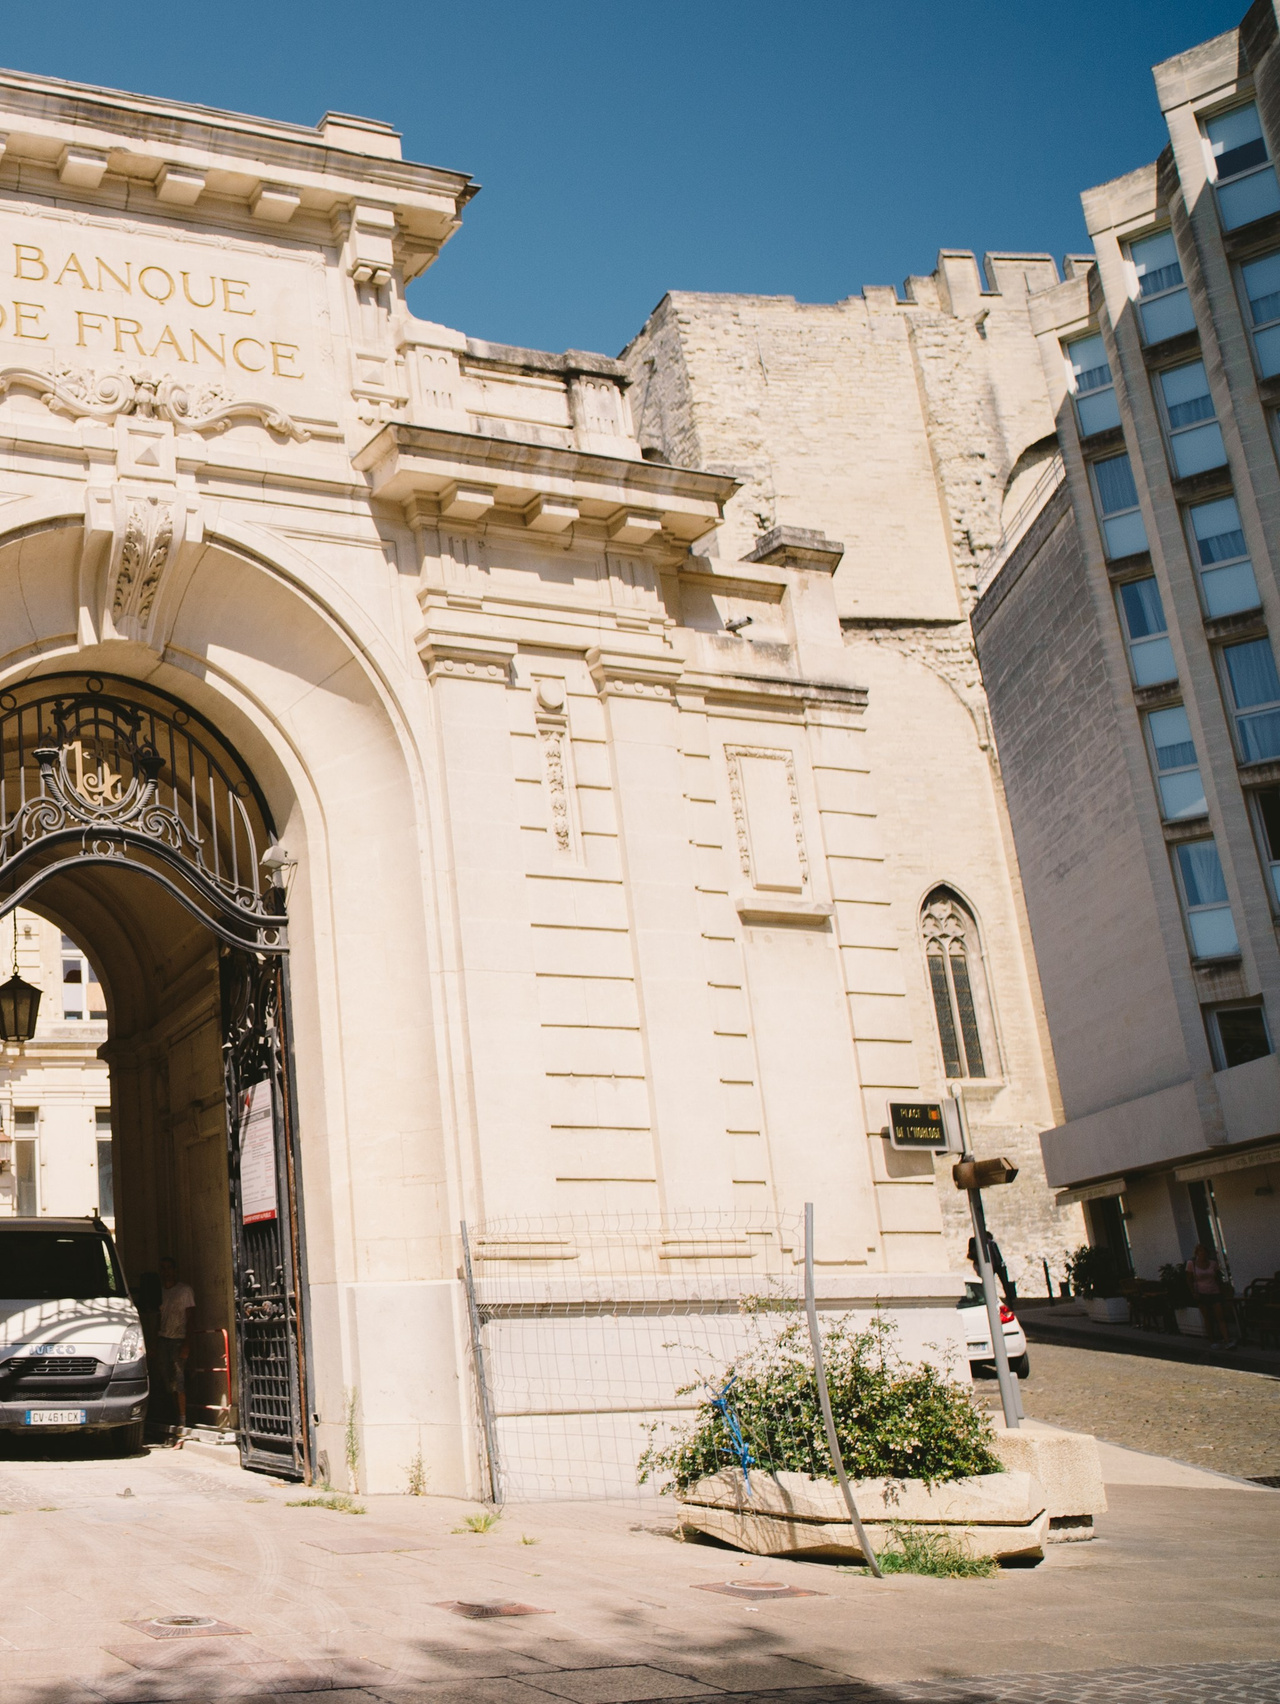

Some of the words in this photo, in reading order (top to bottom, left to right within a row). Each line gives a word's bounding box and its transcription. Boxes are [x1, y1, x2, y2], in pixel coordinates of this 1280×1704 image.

[12, 243, 256, 316] BANQUE
[74, 310, 305, 380] FRANCE
[900, 1108, 922, 1118] PLACE
[29, 1345, 76, 1355] IVECO
